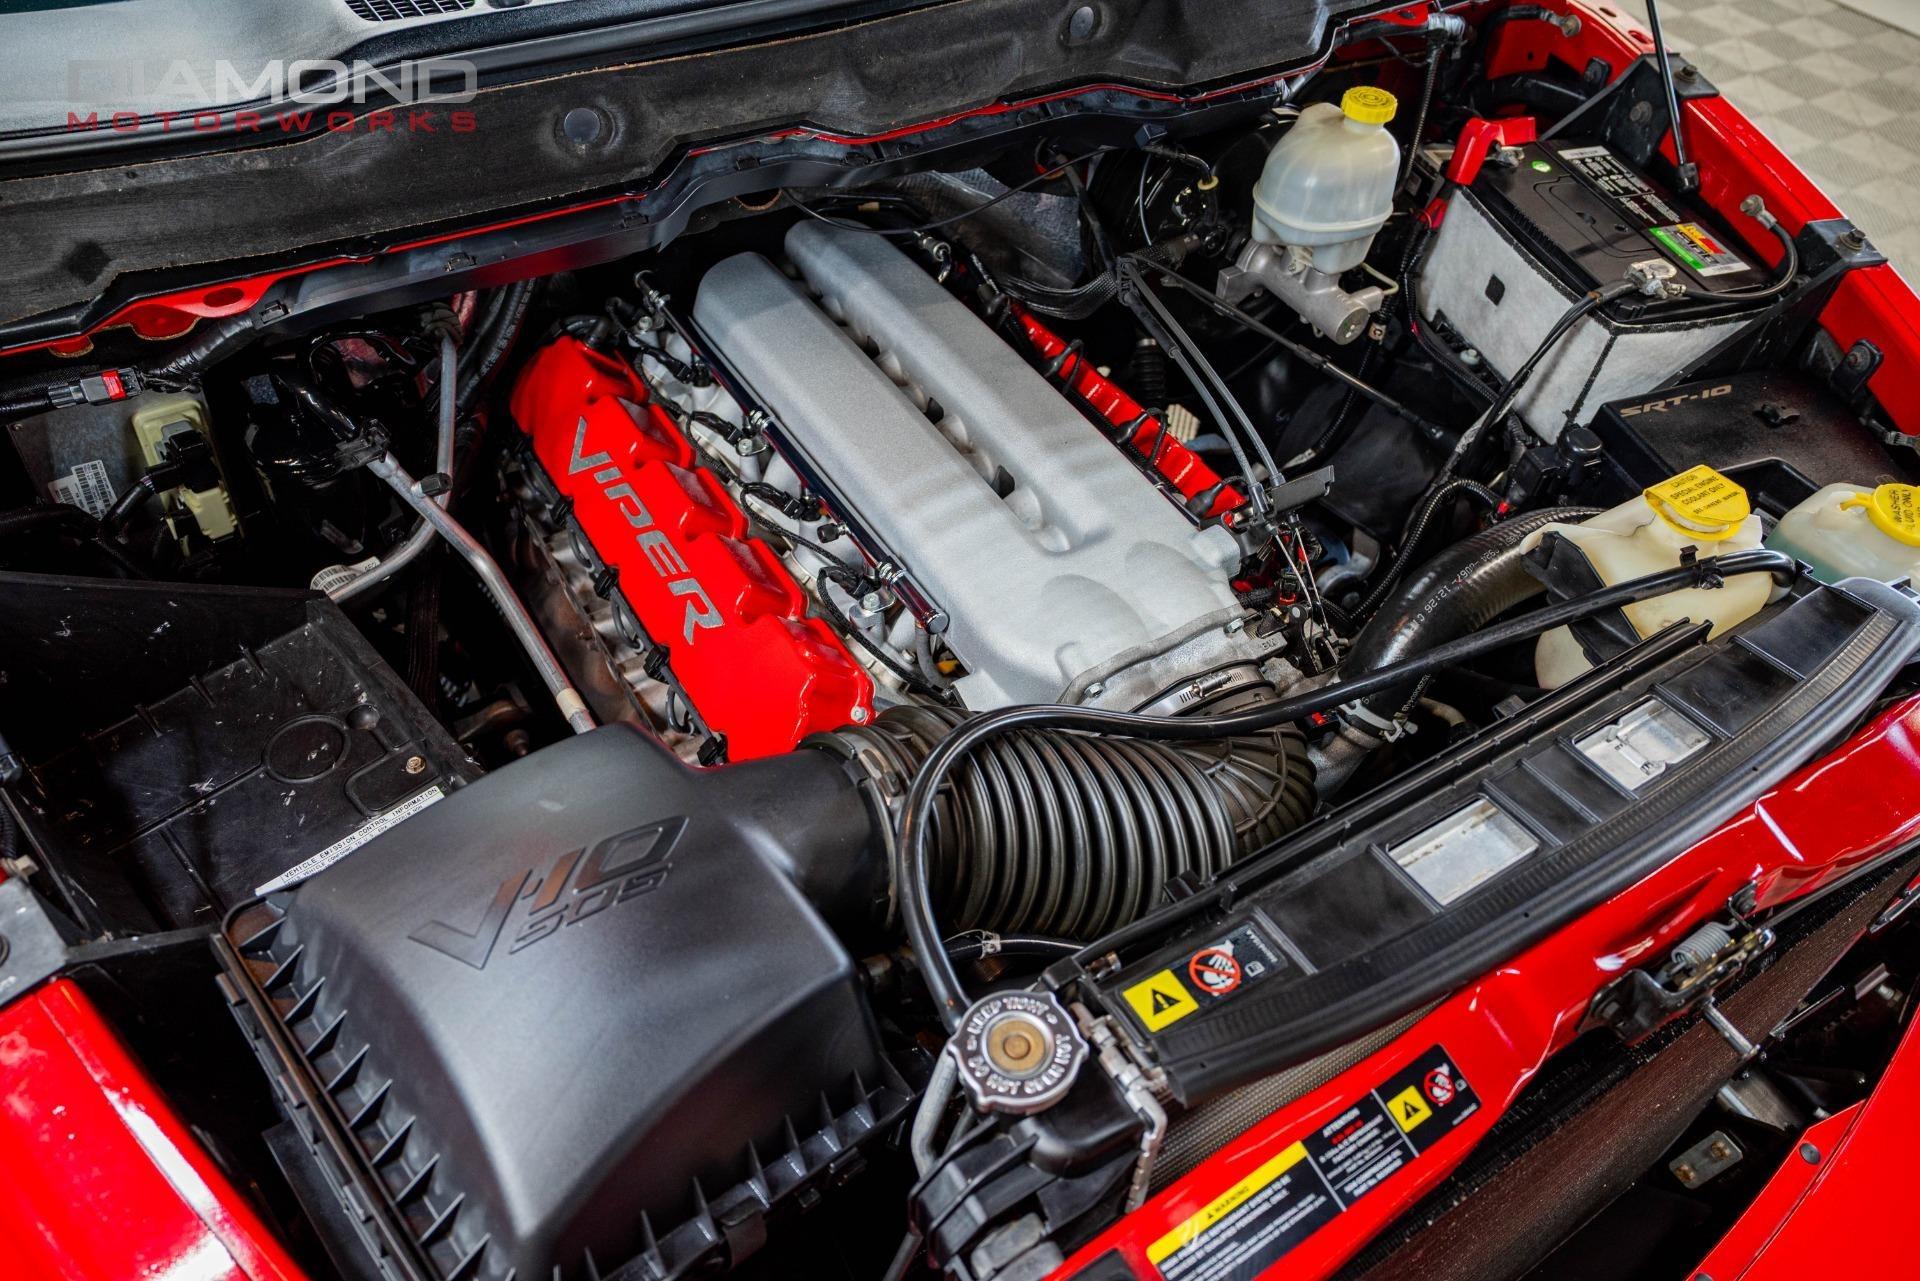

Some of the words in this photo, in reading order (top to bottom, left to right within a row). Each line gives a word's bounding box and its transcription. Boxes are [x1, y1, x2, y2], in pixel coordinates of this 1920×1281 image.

[1619, 384, 1732, 417] SRT-10
[1670, 485, 1697, 500] SPECIAL
[1695, 475, 1720, 490] ENGINE
[1681, 488, 1709, 505] COOLANT
[1708, 483, 1726, 495] ONLY
[568, 416, 724, 645] VIPER
[1424, 585, 1451, 614] 12:26
[284, 857, 316, 878] VEHICLE
[319, 835, 355, 858] EMISSION
[357, 815, 388, 836] CONTROL
[391, 787, 437, 816] INFORMATION
[407, 815, 689, 970] V10
[986, 1074, 1022, 1095] NOT
